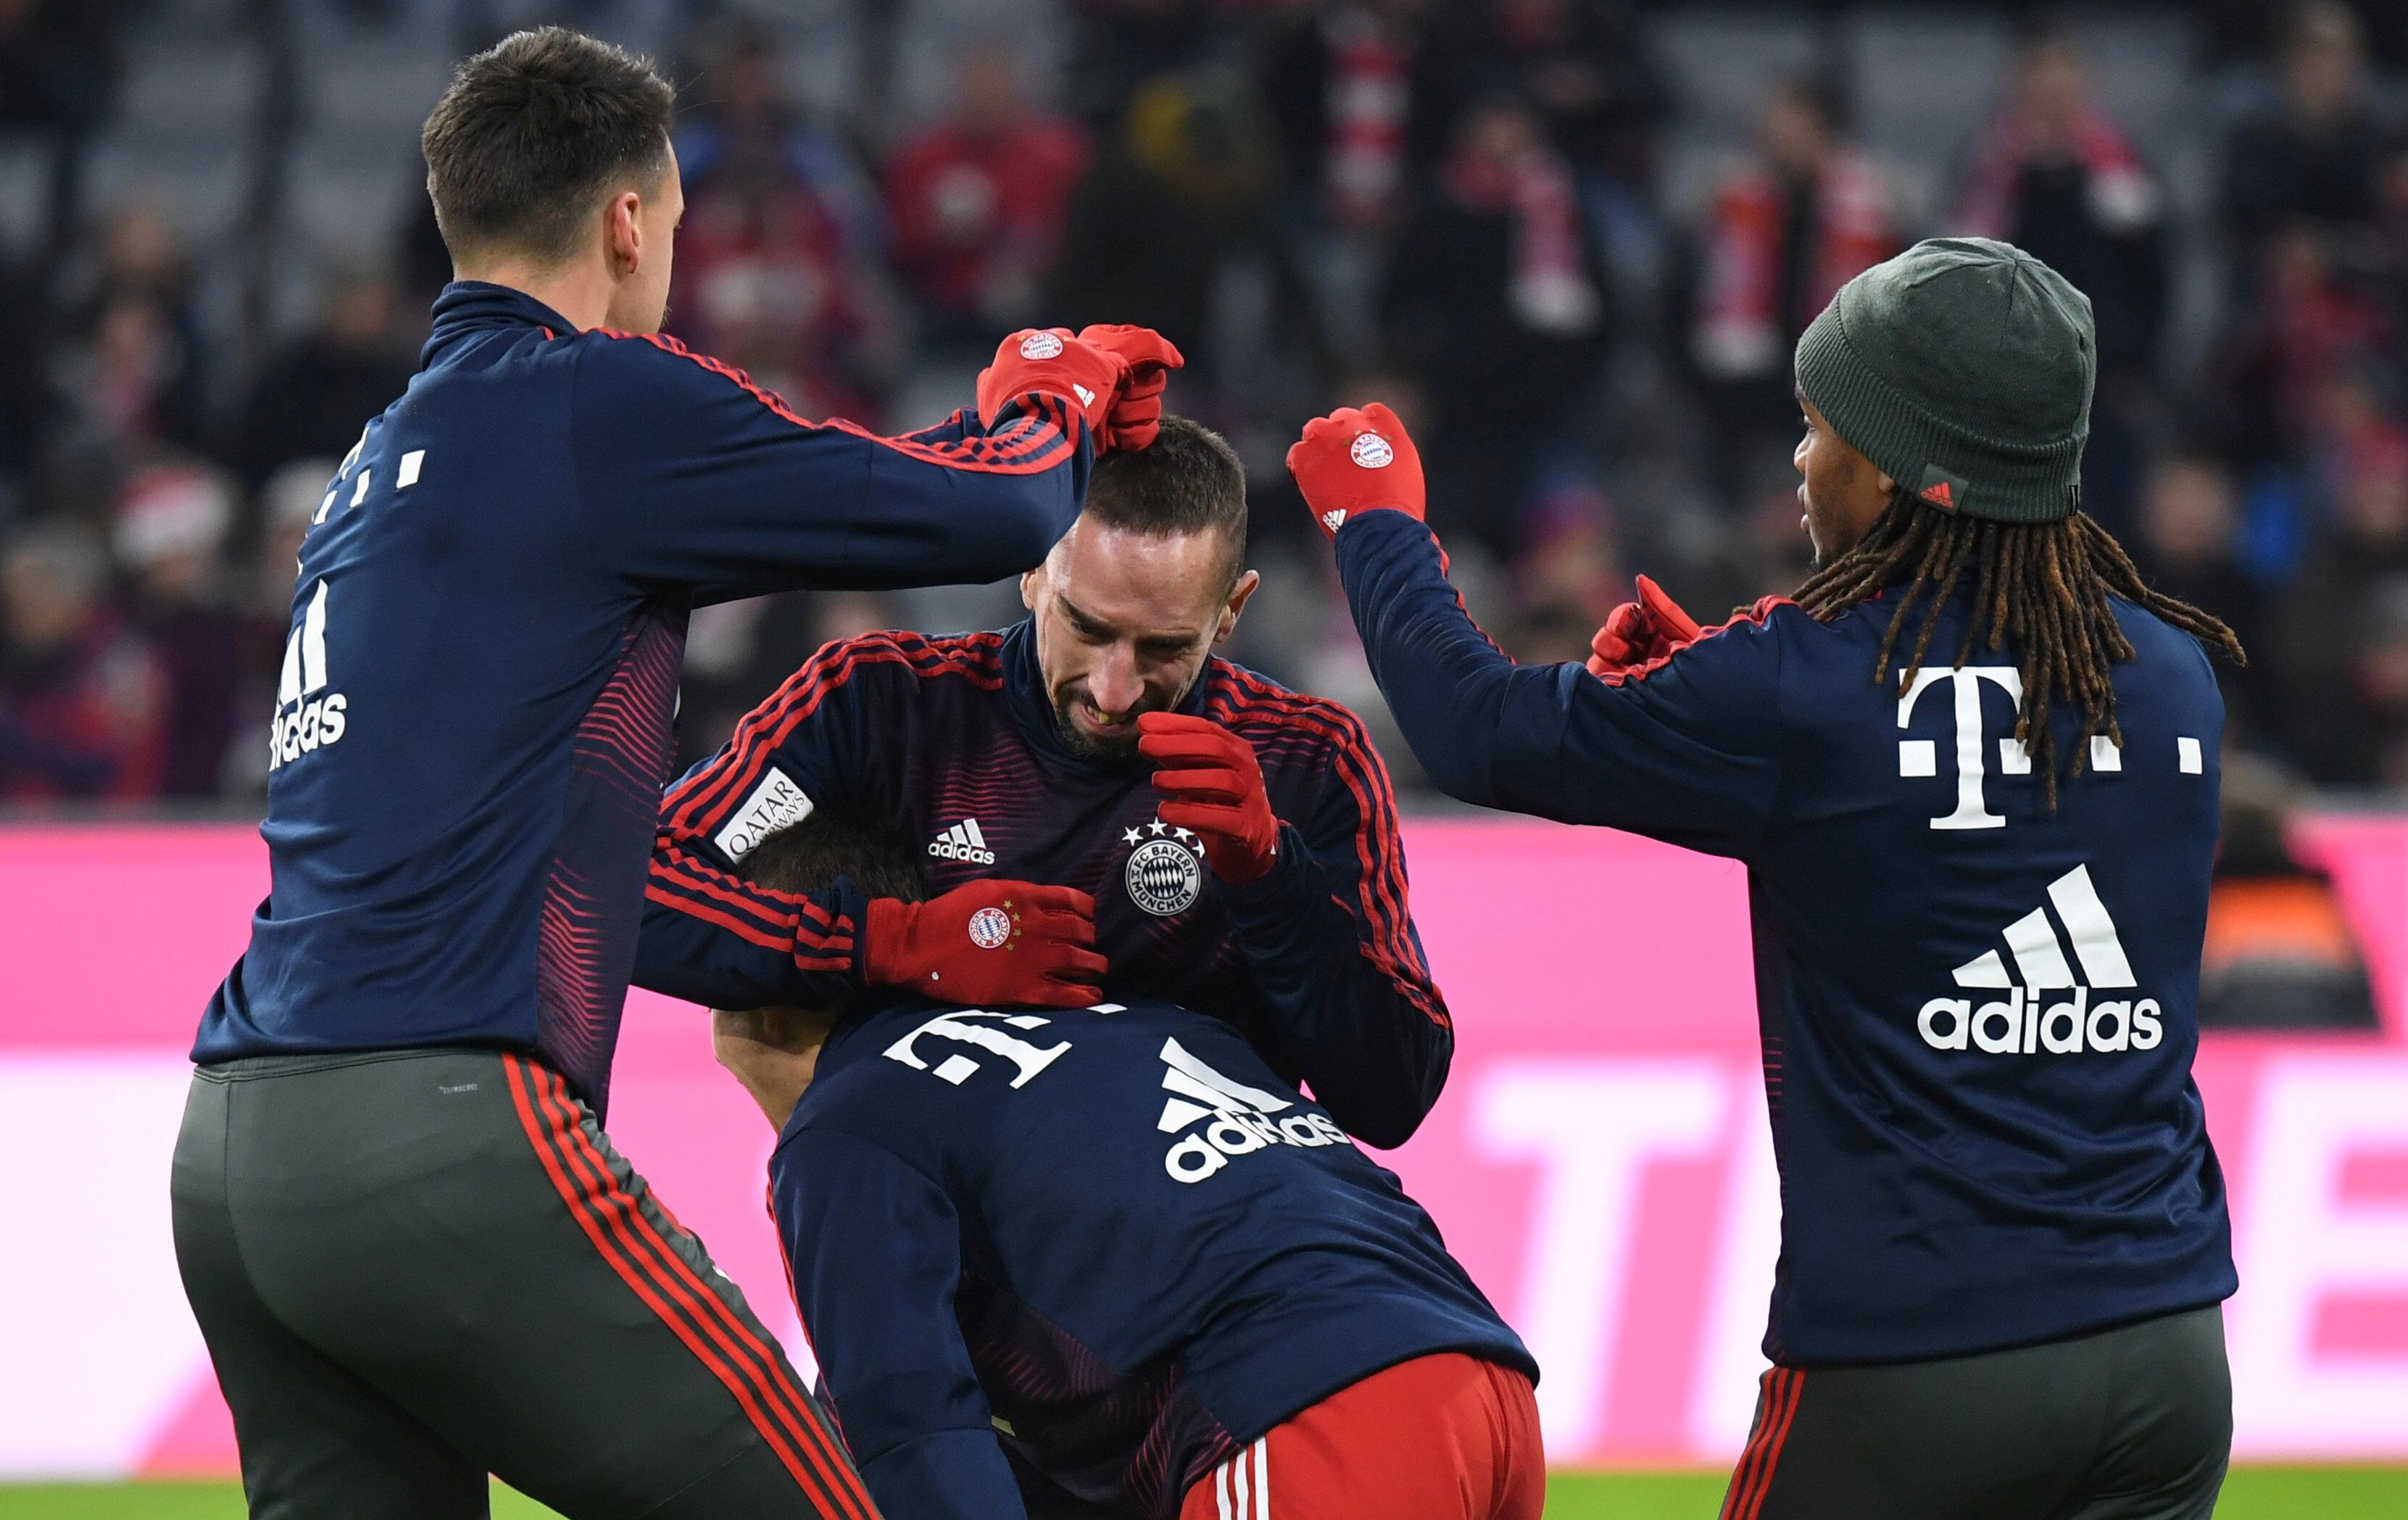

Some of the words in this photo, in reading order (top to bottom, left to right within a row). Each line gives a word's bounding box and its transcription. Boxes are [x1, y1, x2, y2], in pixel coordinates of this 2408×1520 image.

[729, 780, 794, 855] QATAR
[928, 842, 995, 865] adidas
[1134, 852, 1150, 869] FC
[1151, 846, 1195, 877] BAYERN
[1917, 987, 2163, 1054] adidas
[1165, 1108, 1352, 1183] adidas
